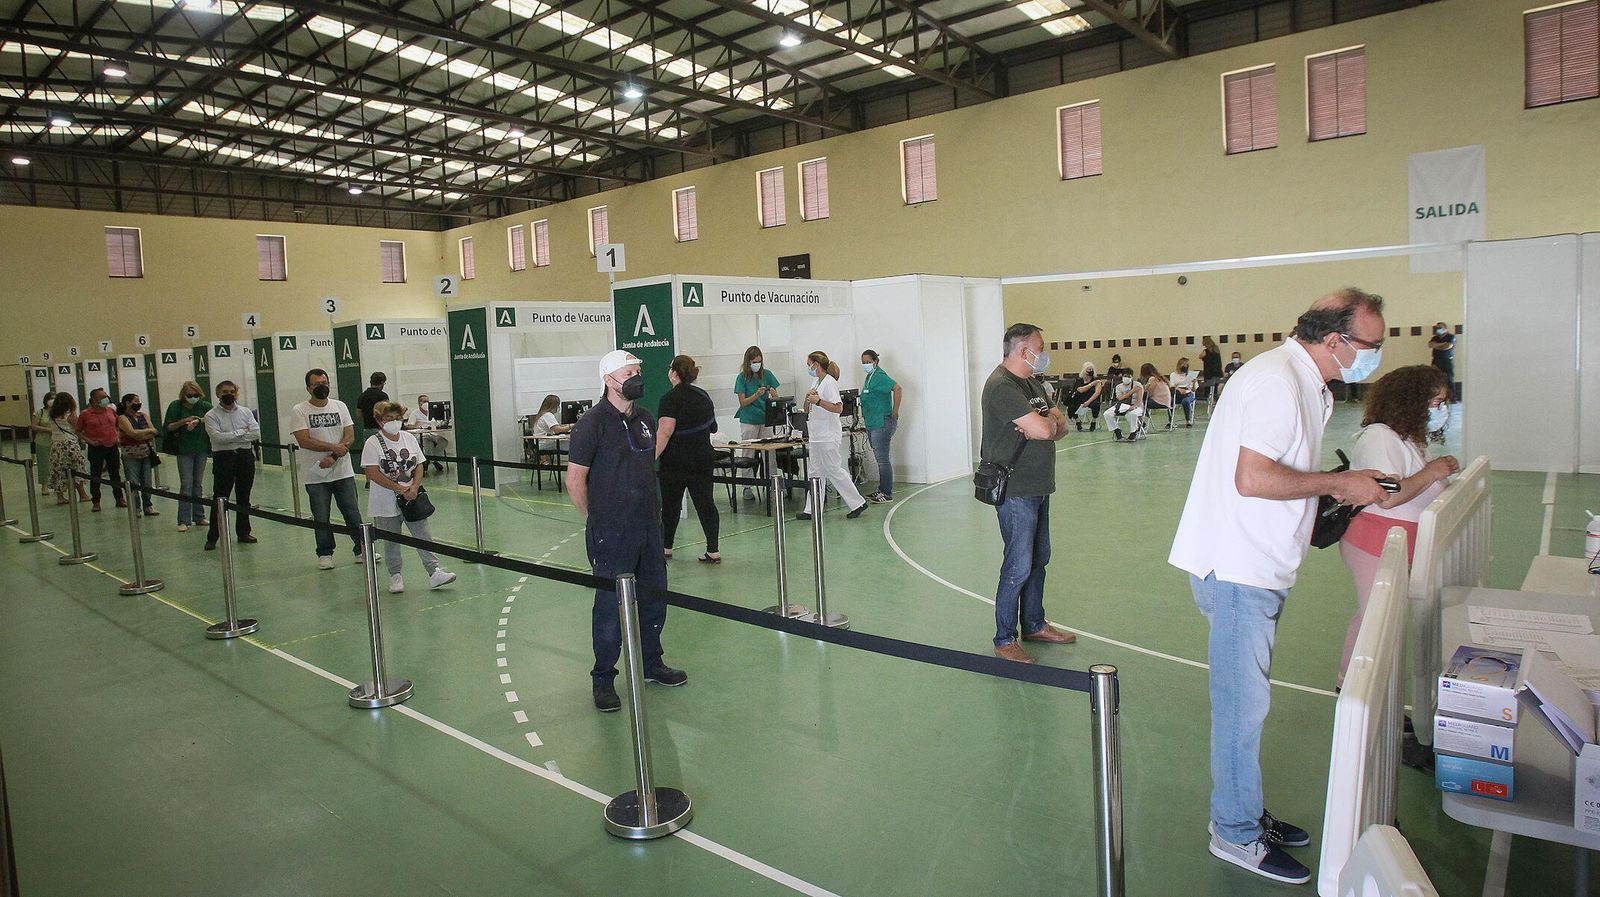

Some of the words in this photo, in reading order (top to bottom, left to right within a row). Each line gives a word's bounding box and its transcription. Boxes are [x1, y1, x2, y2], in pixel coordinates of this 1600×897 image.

[1415, 202, 1479, 220] SALIDA
[606, 248, 616, 268] 1
[440, 278, 452, 294] 2
[721, 290, 752, 303] Punto
[754, 290, 766, 303] de
[768, 290, 820, 304] Vacunación
[326, 300, 336, 313] 3
[246, 315, 256, 327] 4
[532, 312, 562, 323] Punto
[564, 312, 576, 323] de
[578, 312, 611, 323] Vacuna
[187, 327, 195, 337] 5
[400, 327, 428, 336] Punto
[430, 327, 442, 336] de
[102, 342, 108, 351] 7
[139, 336, 146, 346] 6
[644, 338, 670, 348] Andalucía
[1502, 708, 1512, 720] S
[1491, 744, 1509, 760] M
